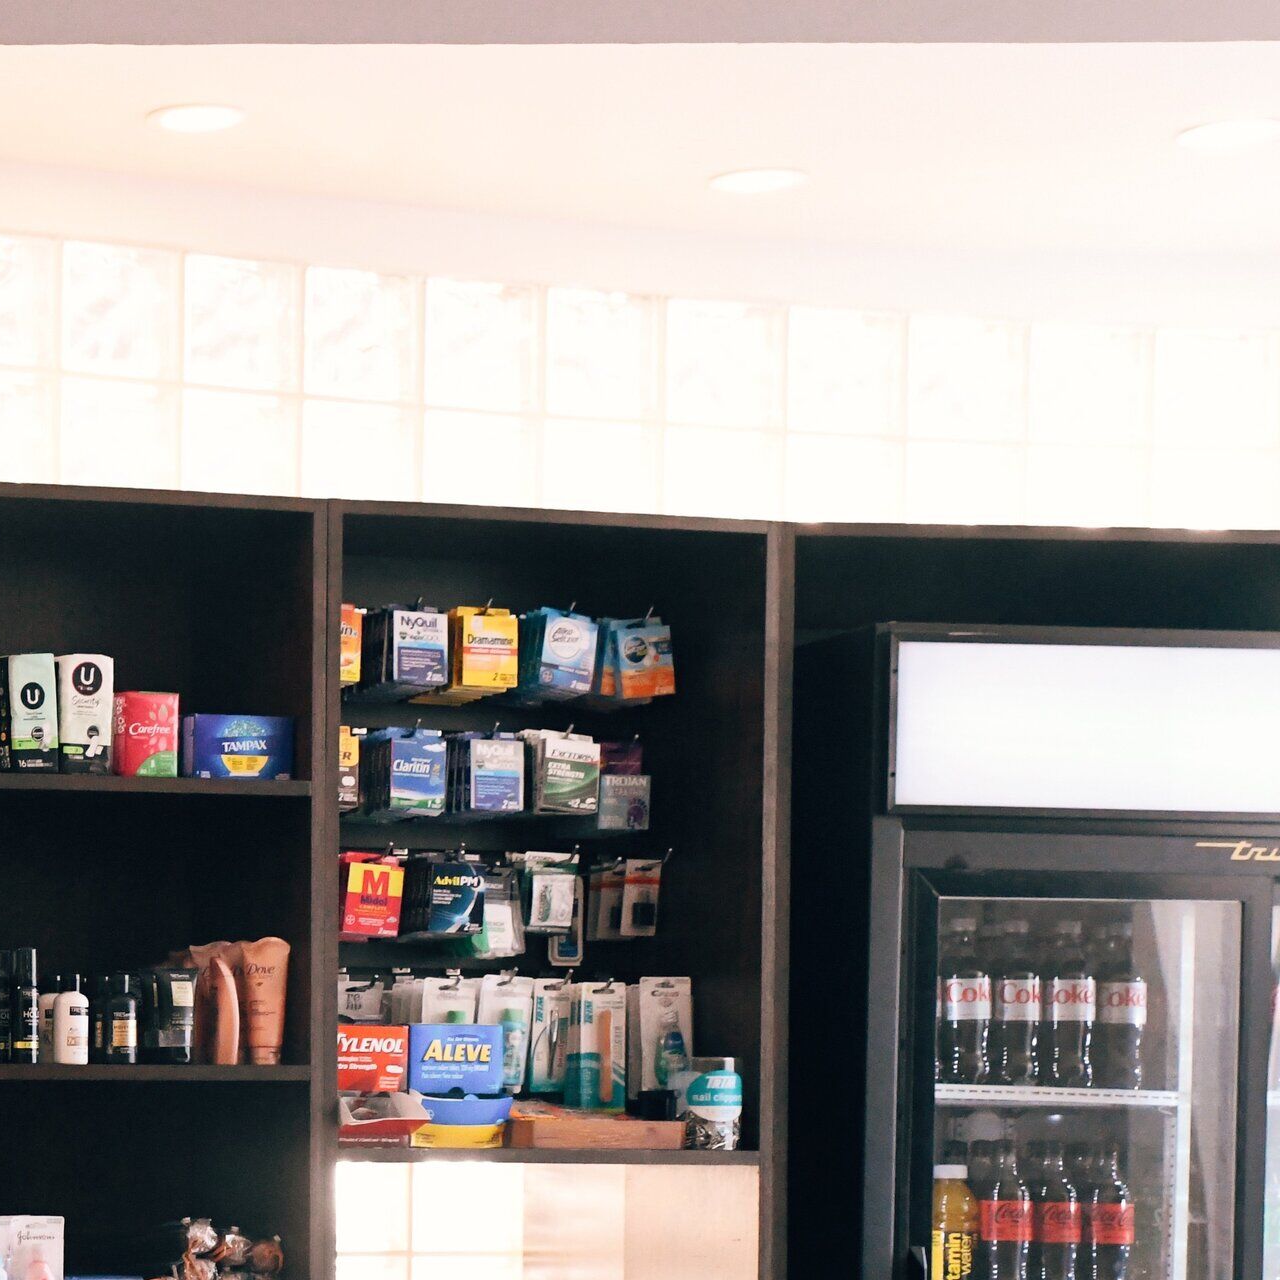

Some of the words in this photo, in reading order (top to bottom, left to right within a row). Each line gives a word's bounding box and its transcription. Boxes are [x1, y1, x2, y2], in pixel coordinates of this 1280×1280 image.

[400, 615, 438, 629] NyQuil
[467, 632, 513, 645] Dramamine
[80, 666, 95, 685] U
[426, 671, 433, 680] 2
[492, 672, 499, 681] 2
[26, 688, 39, 705] U
[129, 722, 171, 736] Carefree
[222, 739, 267, 753] TAMPAX
[18, 759, 27, 767] 16
[393, 759, 430, 775] Claritin
[548, 762, 571, 770] EXTRA
[548, 769, 585, 778] STRENGTH
[605, 775, 647, 787] TROJAN
[502, 800, 509, 809] 2
[1195, 840, 1280, 862] tru
[362, 870, 386, 895] M
[434, 875, 459, 887] Advil
[460, 876, 479, 888] PM
[360, 892, 388, 905] Midol
[247, 963, 275, 975] Dove
[337, 1034, 404, 1053] TYLENOL
[422, 1039, 492, 1063] ALEVE
[349, 1063, 378, 1071] Strength
[692, 1092, 712, 1102] nail
[961, 1231, 971, 1275] water
